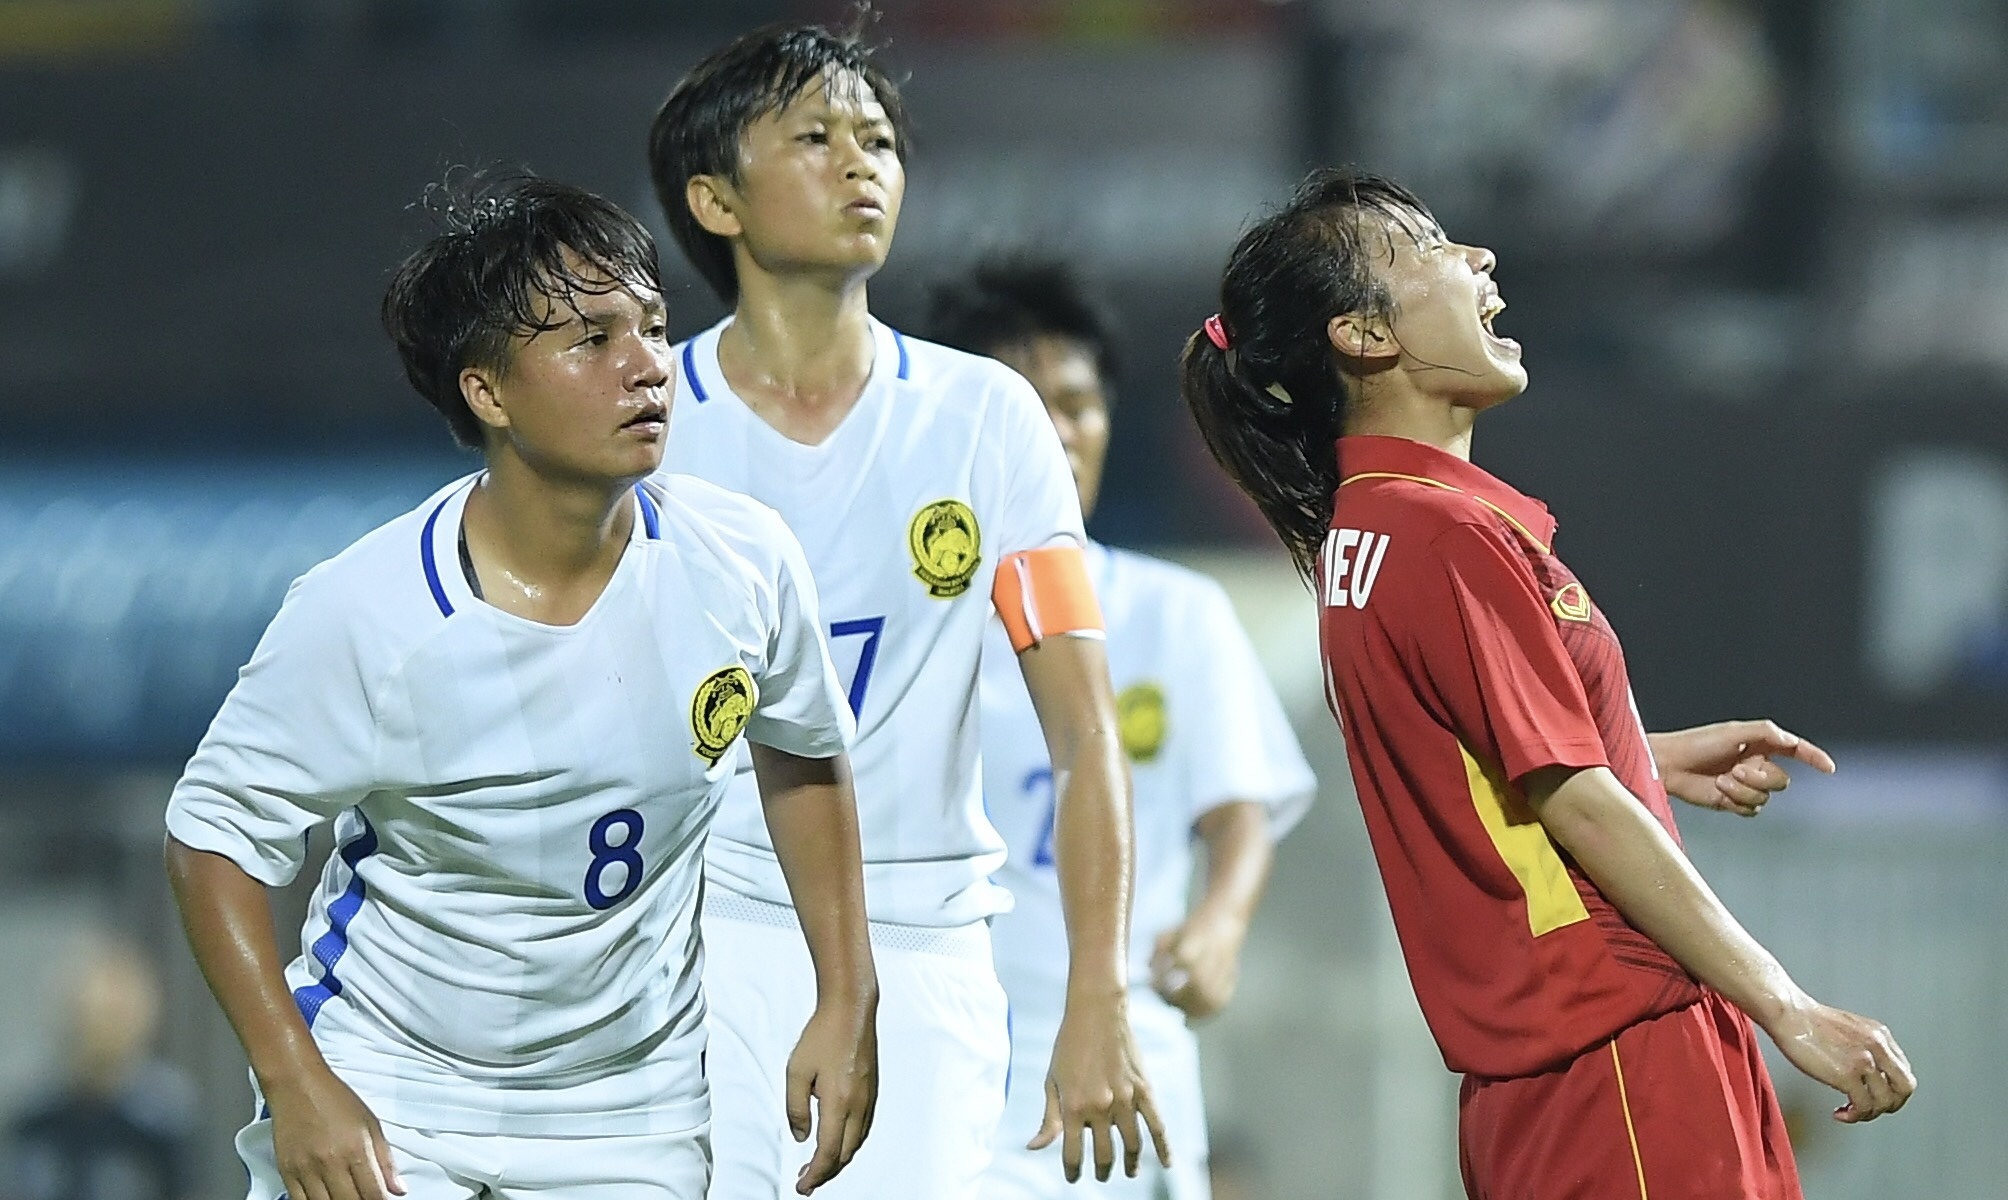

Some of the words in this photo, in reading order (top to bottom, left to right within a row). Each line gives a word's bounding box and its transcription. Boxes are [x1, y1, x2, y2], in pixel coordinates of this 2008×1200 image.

[1321, 528, 1391, 609] IEU
[830, 615, 886, 723] 7
[584, 808, 645, 910] 8
